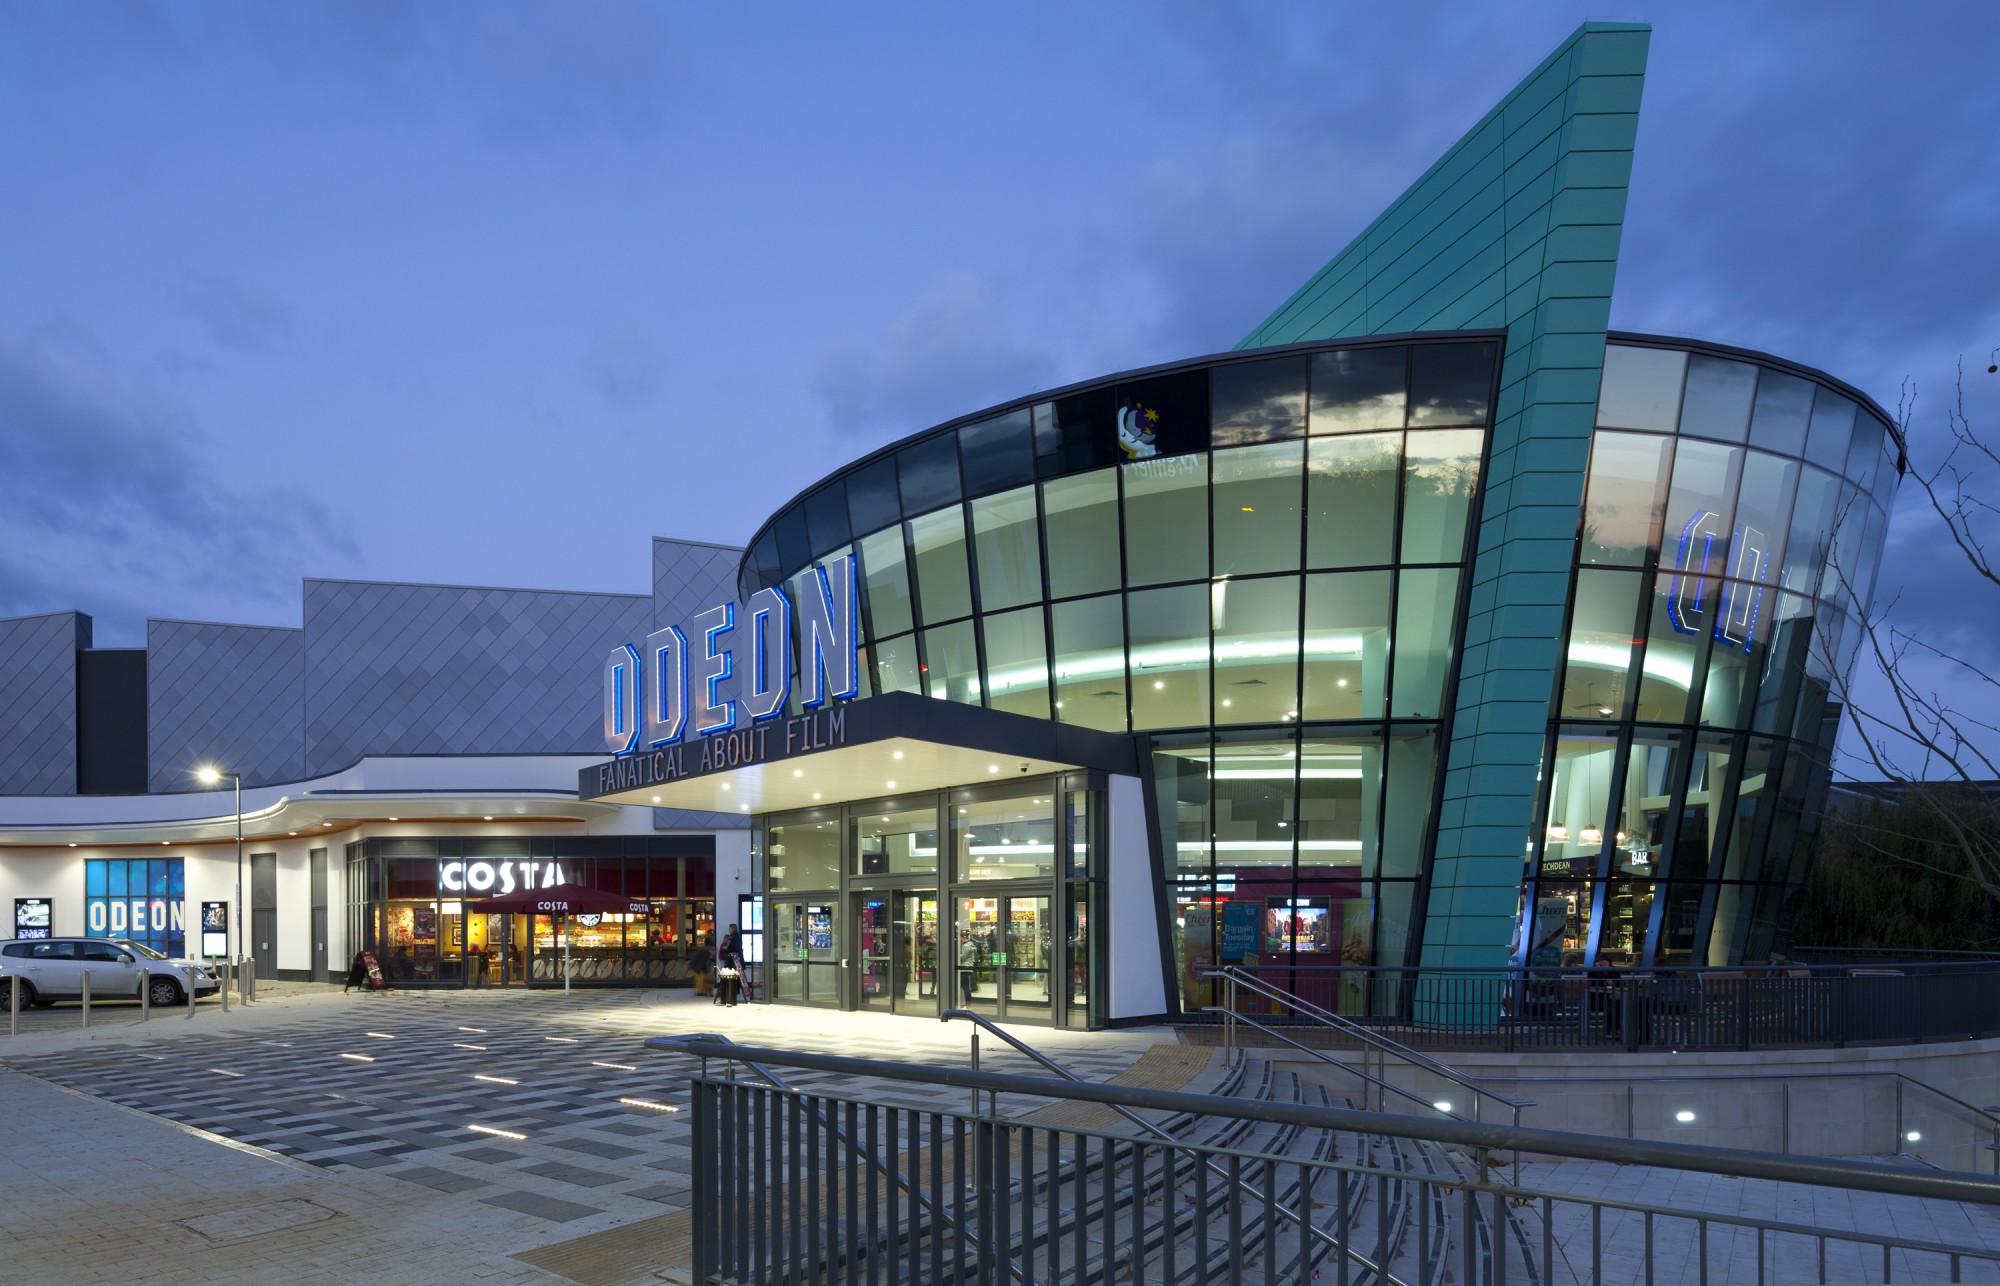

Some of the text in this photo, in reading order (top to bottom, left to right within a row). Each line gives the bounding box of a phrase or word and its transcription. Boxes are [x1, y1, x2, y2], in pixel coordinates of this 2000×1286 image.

[603, 552, 858, 758] ODEON
[599, 708, 846, 793] FANATICAL ABOUT FILM
[1631, 851, 1648, 865] BAR
[1541, 861, 1571, 871] ECHDEAN
[441, 862, 565, 894] COSTA
[537, 901, 569, 911] COSTA
[1286, 898, 1310, 907] OEON
[629, 903, 650, 913] COSTA
[90, 900, 185, 931] ODEON
[1185, 913, 1212, 924] Cheer
[1224, 924, 1253, 934] Bargain
[1225, 934, 1255, 943] Tuesday
